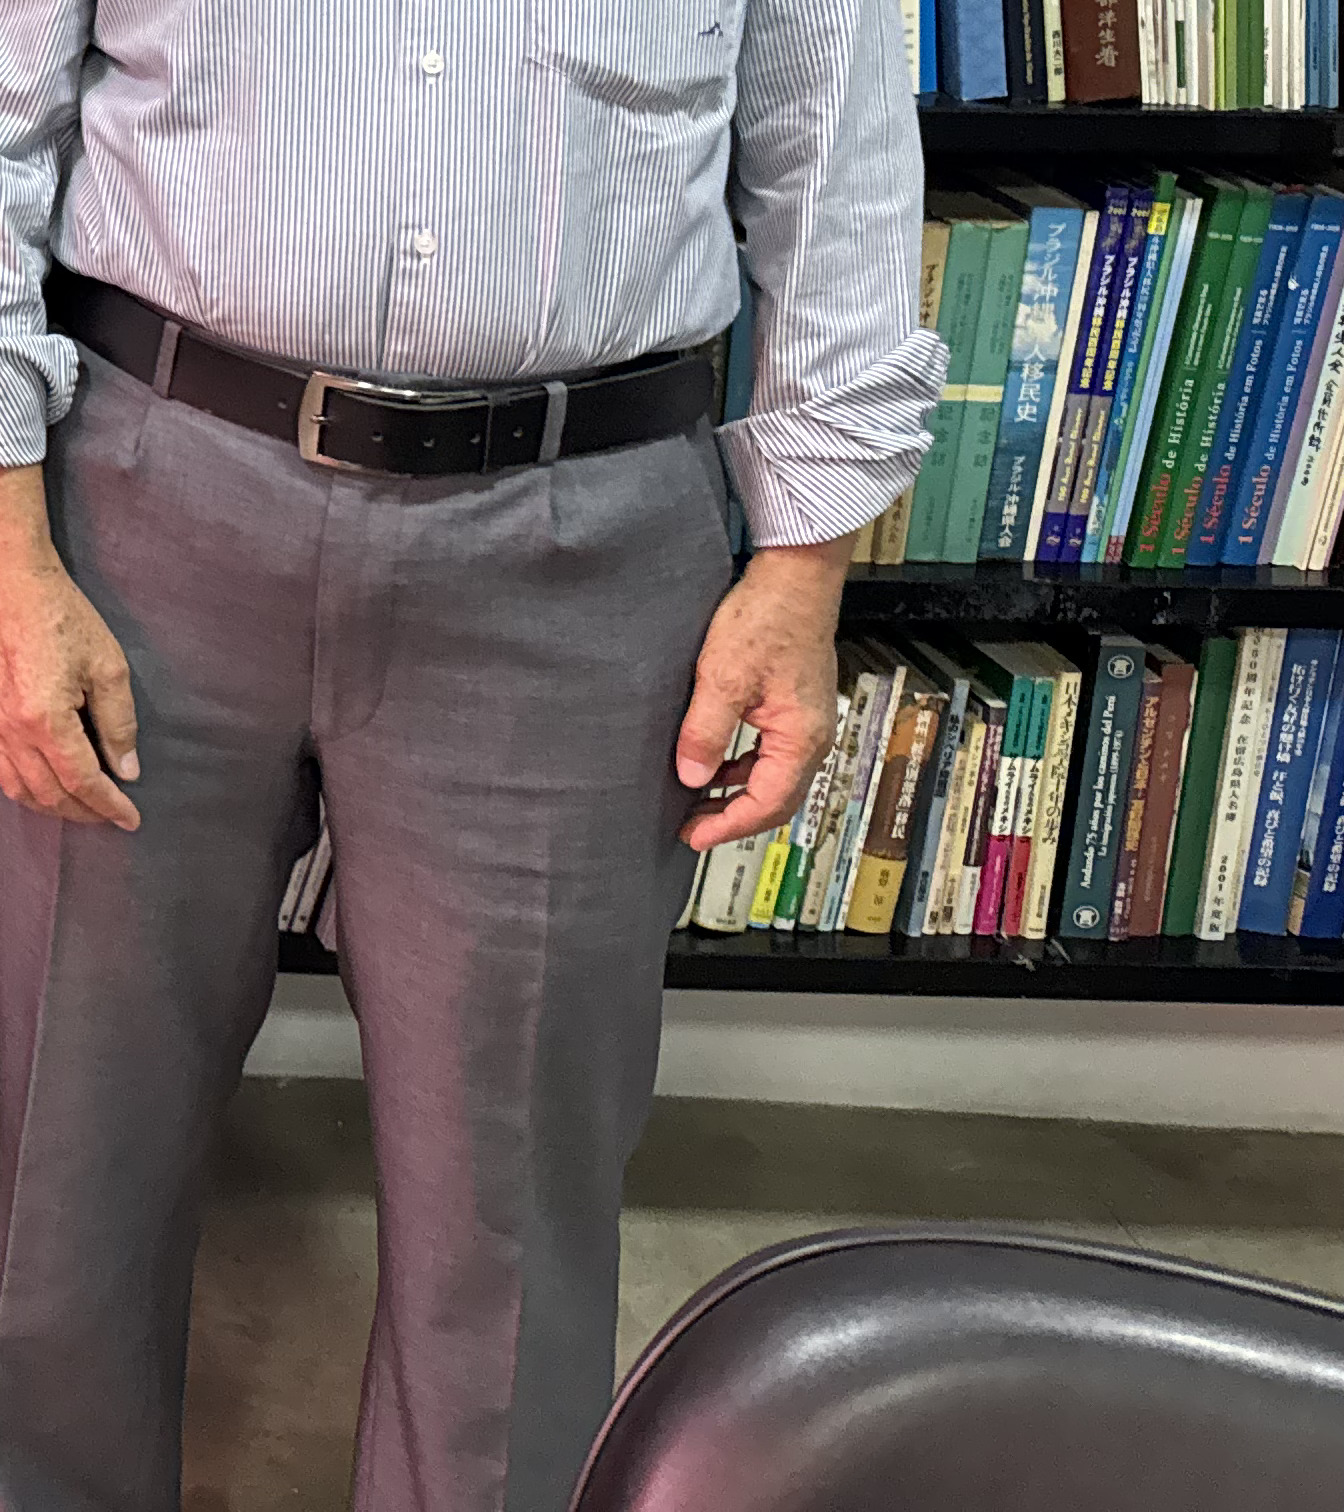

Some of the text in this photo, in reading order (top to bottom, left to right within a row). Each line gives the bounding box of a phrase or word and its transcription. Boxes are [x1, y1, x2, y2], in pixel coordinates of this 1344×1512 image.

[1247, 340, 1263, 374] Fotos
[1287, 340, 1303, 375] Fotos
[1244, 375, 1255, 394] em
[1284, 375, 1296, 394] em
[1167, 378, 1194, 446] História
[1199, 382, 1225, 449] História
[1228, 391, 1250, 444] História
[1269, 393, 1290, 444] História
[1164, 448, 1176, 469] de
[1194, 450, 1208, 471] de
[1224, 444, 1236, 461] de
[1265, 444, 1276, 461] de
[1202, 464, 1232, 530] Século
[1242, 464, 1271, 530] Século
